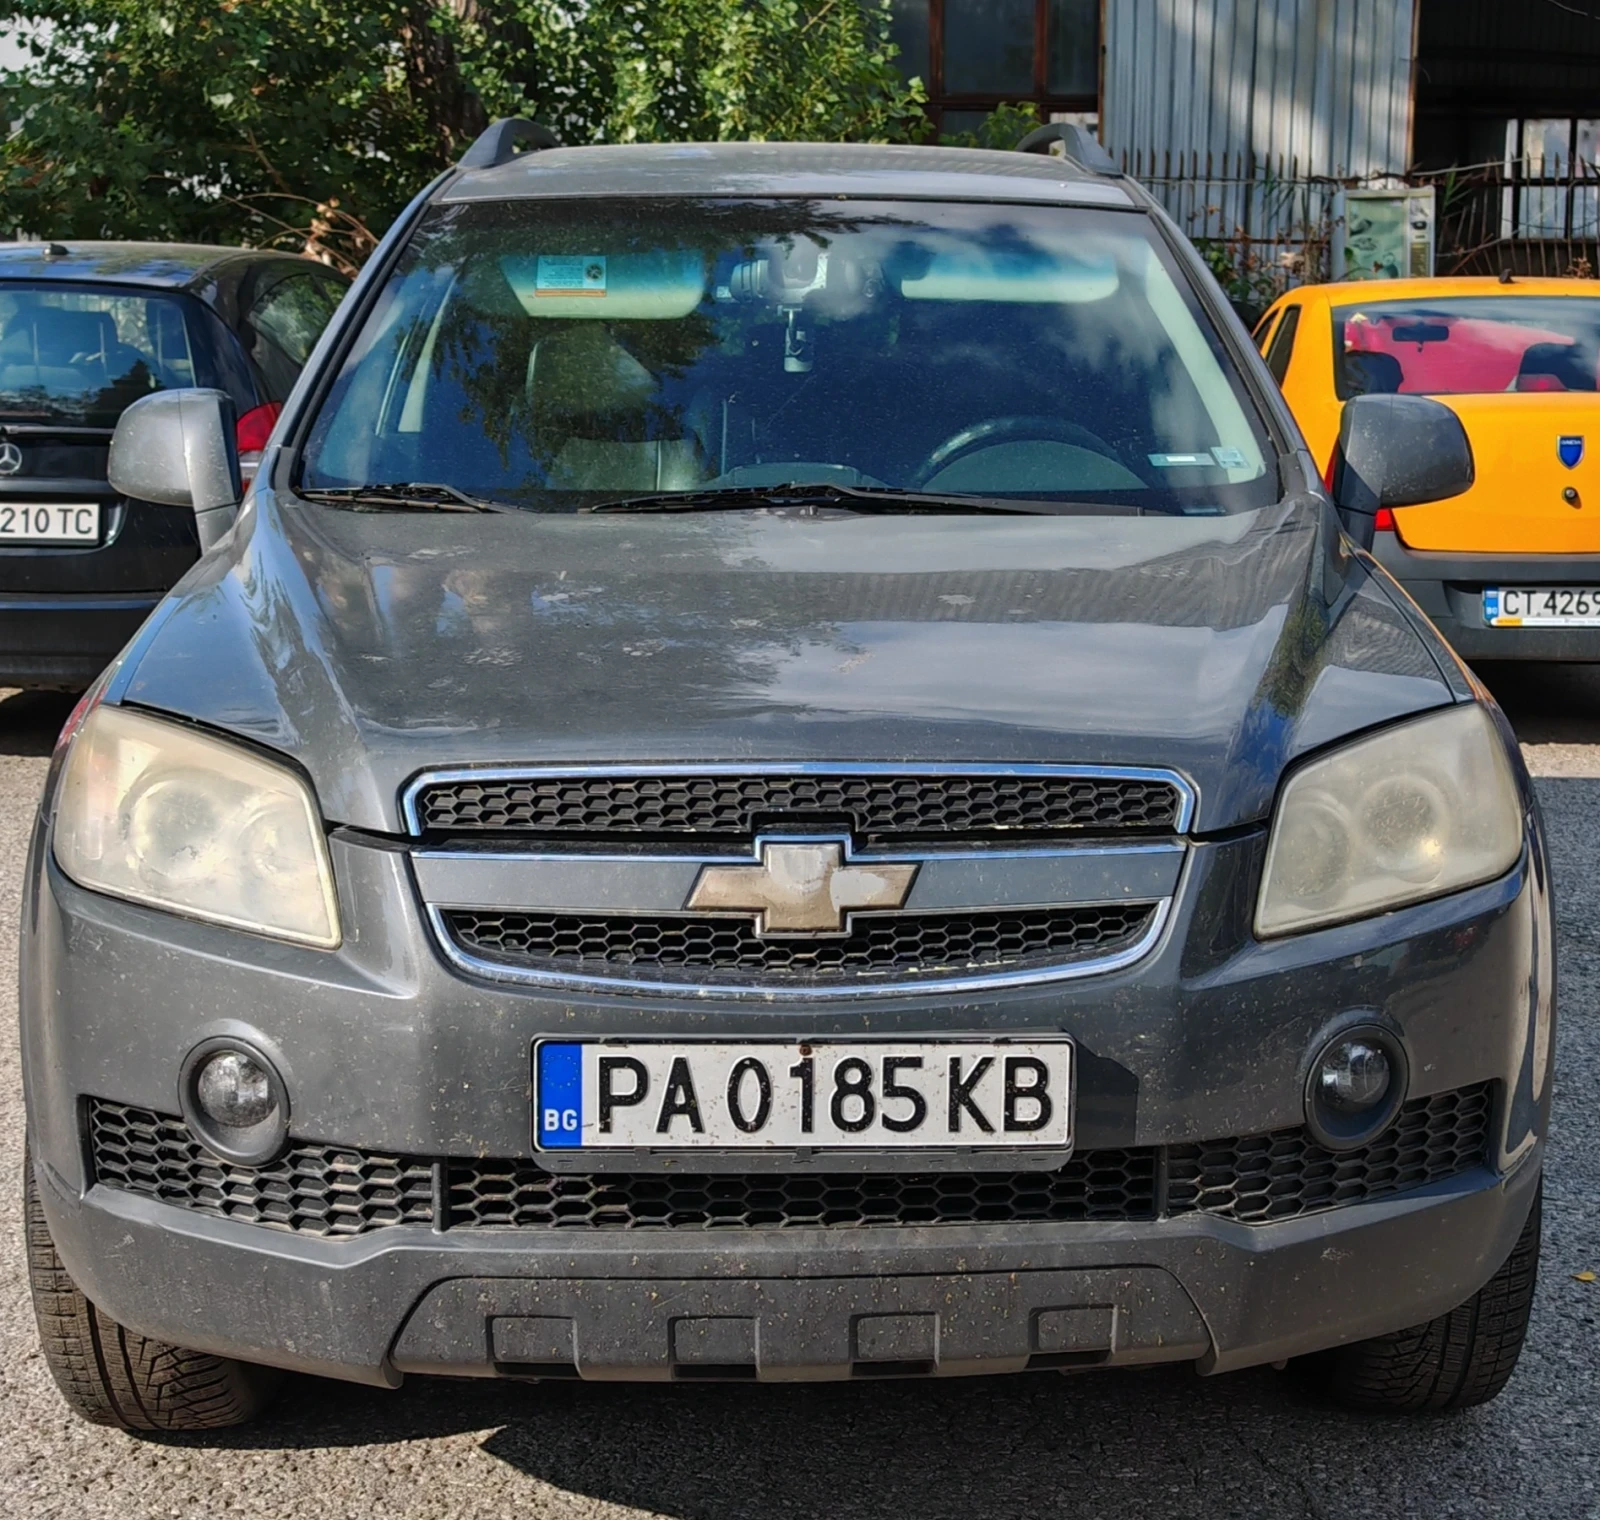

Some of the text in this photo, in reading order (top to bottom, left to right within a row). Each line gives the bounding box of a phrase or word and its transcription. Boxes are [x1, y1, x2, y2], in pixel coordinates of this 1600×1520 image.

[0, 507, 93, 535] 210 TC
[1503, 590, 1537, 616] CT
[596, 1056, 1053, 1133] PA 0185 KB
[544, 1108, 578, 1131] BG
